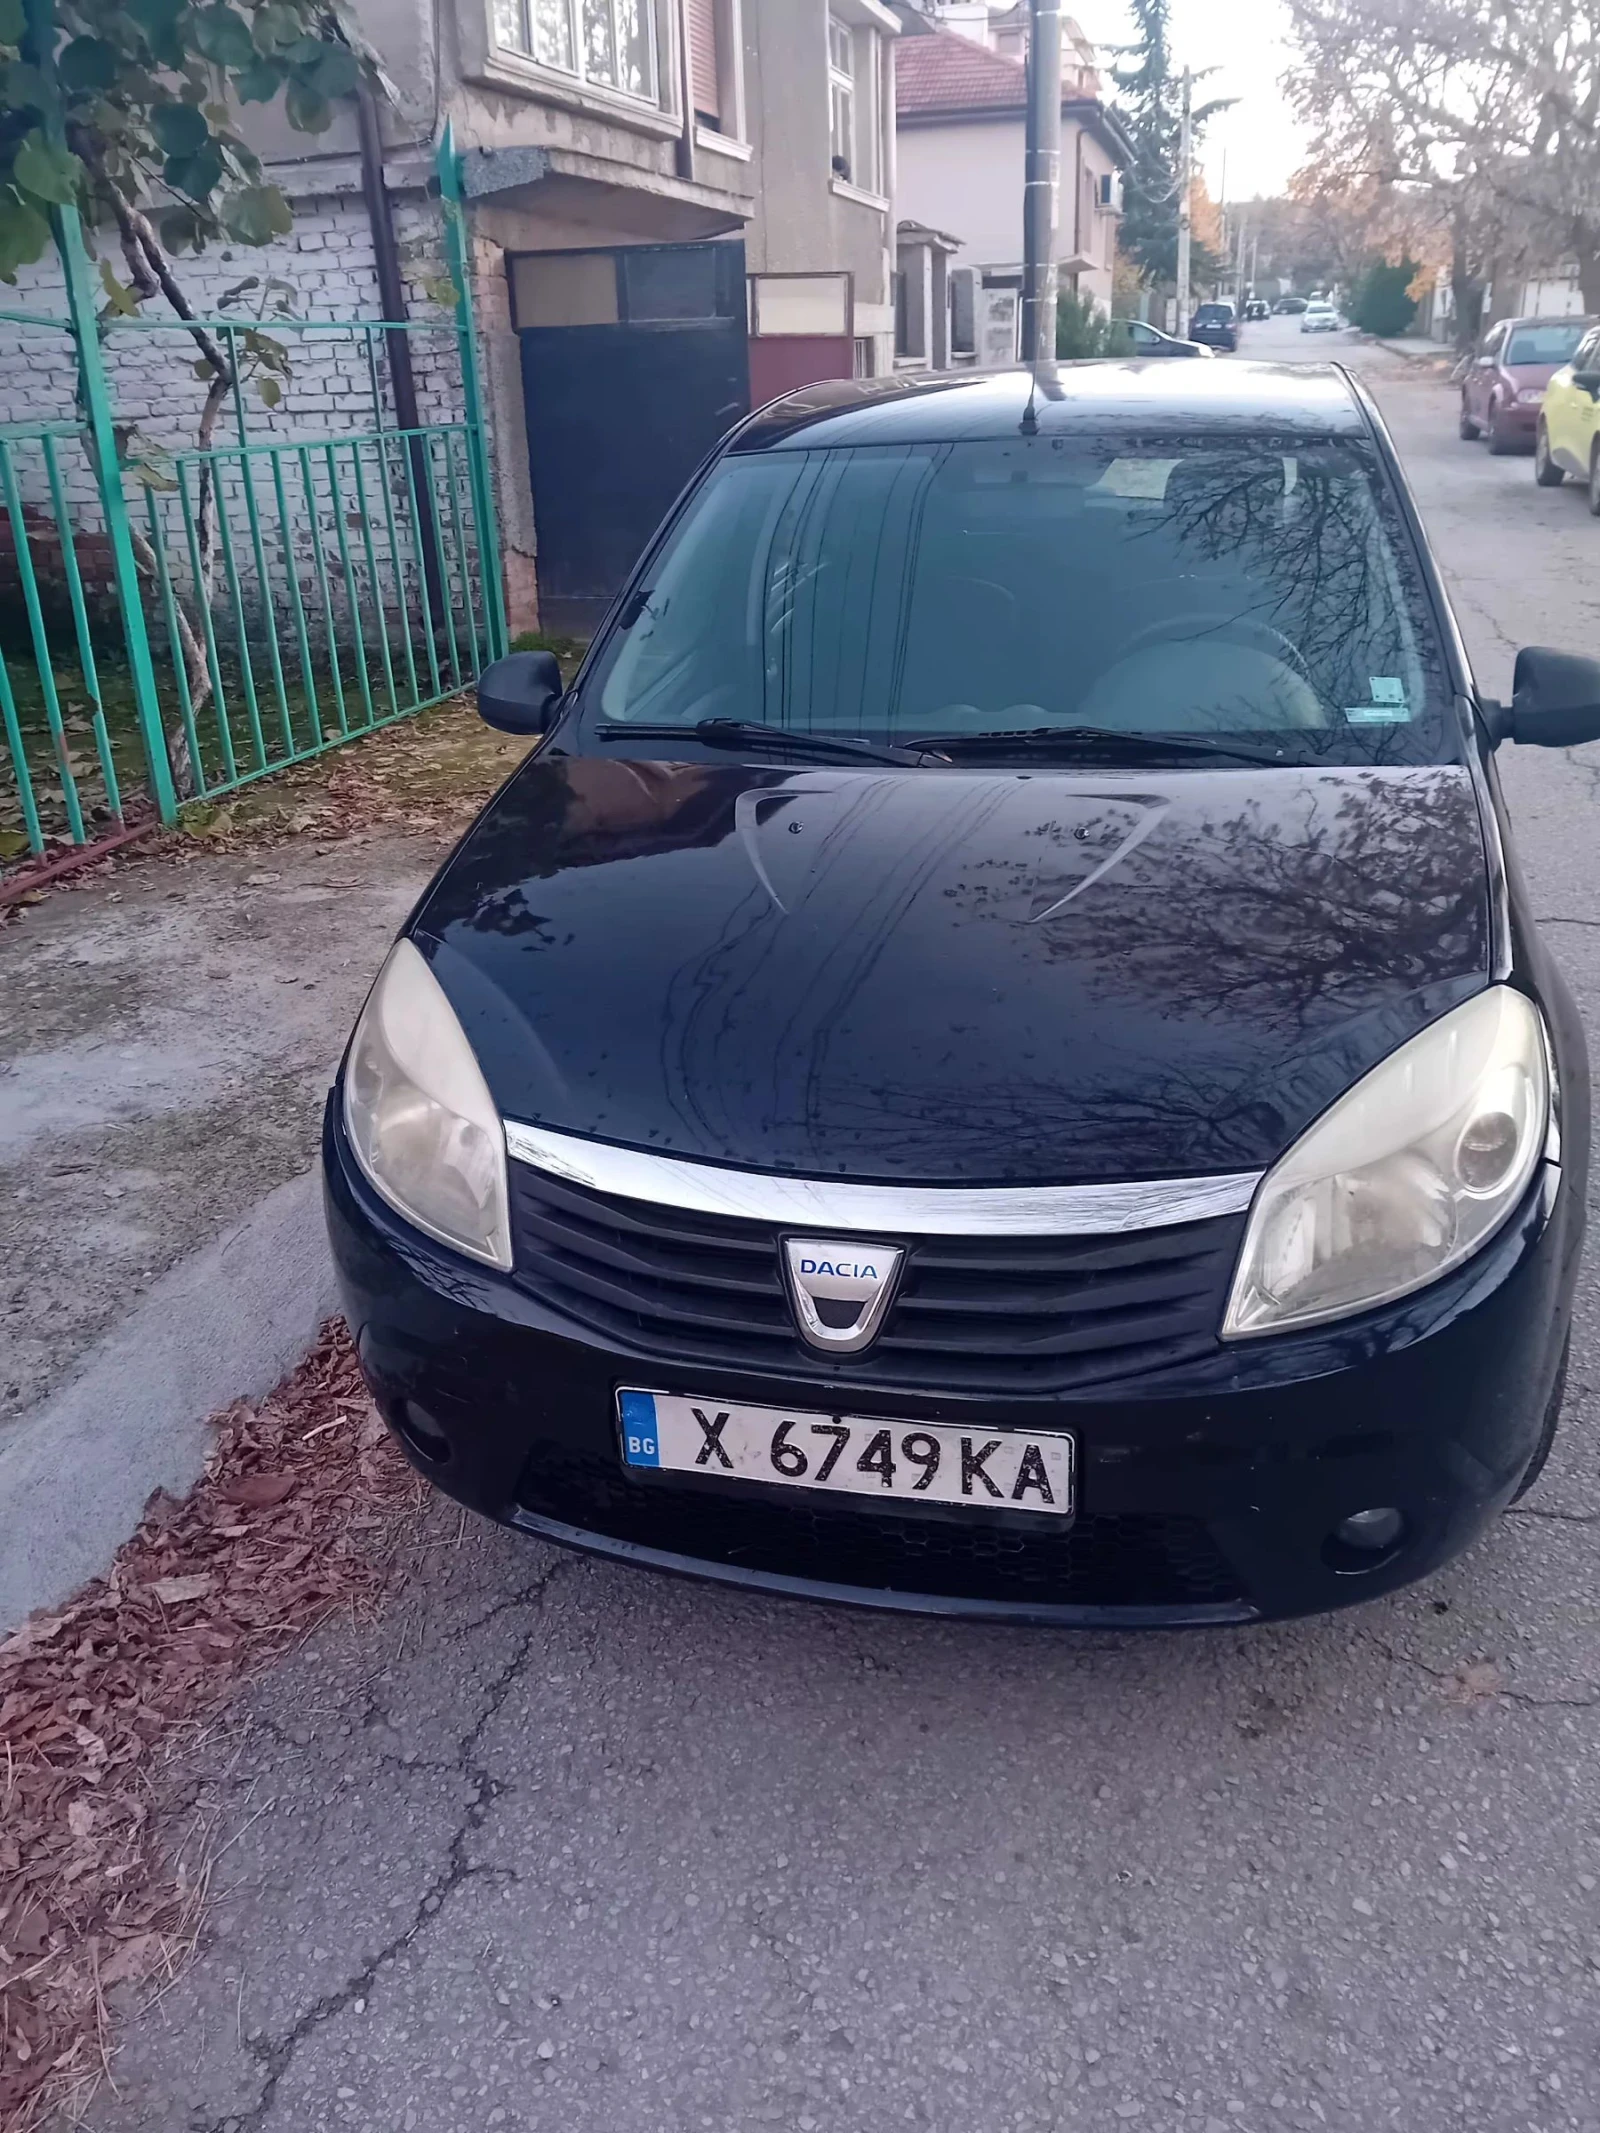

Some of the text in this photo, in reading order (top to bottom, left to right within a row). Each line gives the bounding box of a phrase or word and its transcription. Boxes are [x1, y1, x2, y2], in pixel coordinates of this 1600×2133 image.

[801, 1259, 878, 1279] DACIA
[628, 1437, 655, 1455] BG
[691, 1407, 1055, 1504] X 6749 KA
